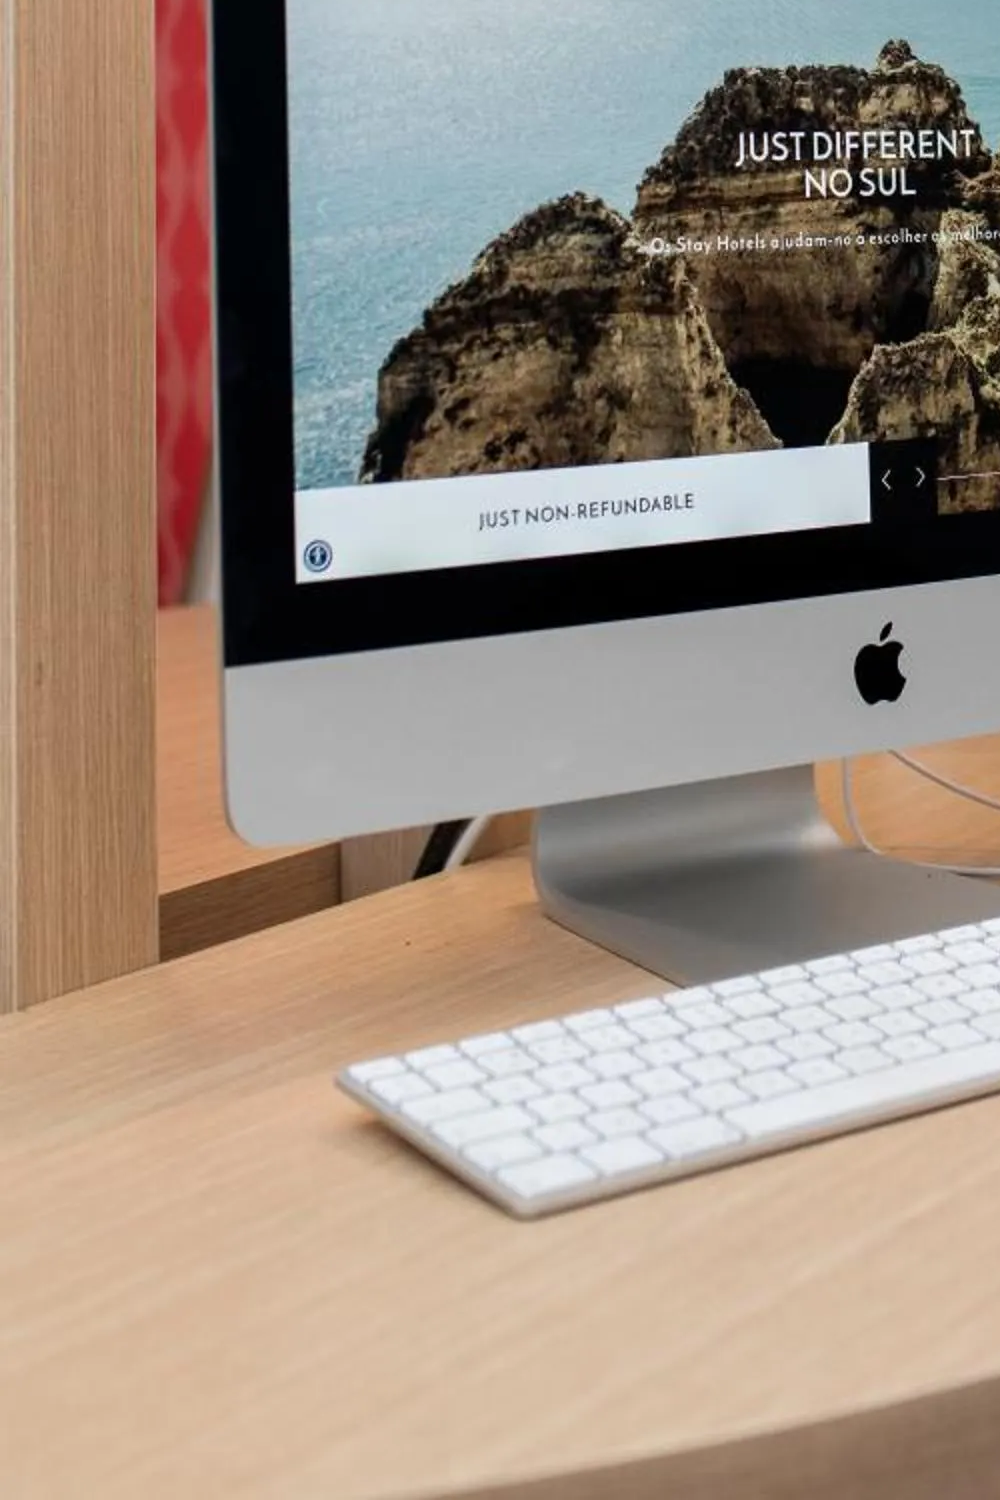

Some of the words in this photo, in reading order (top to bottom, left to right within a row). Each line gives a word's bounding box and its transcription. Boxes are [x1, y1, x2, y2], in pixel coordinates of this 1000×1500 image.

[735, 131, 805, 167] JUST
[812, 129, 976, 161] DIFFERENT
[804, 168, 854, 199] NO
[859, 167, 917, 196] SUL
[676, 235, 713, 256] Stay
[717, 231, 766, 251] Hotels
[769, 231, 852, 251] ajudam-no
[869, 228, 928, 245] escolher
[479, 509, 521, 531] JUST
[525, 492, 695, 525] NON-REFUNDABLE
